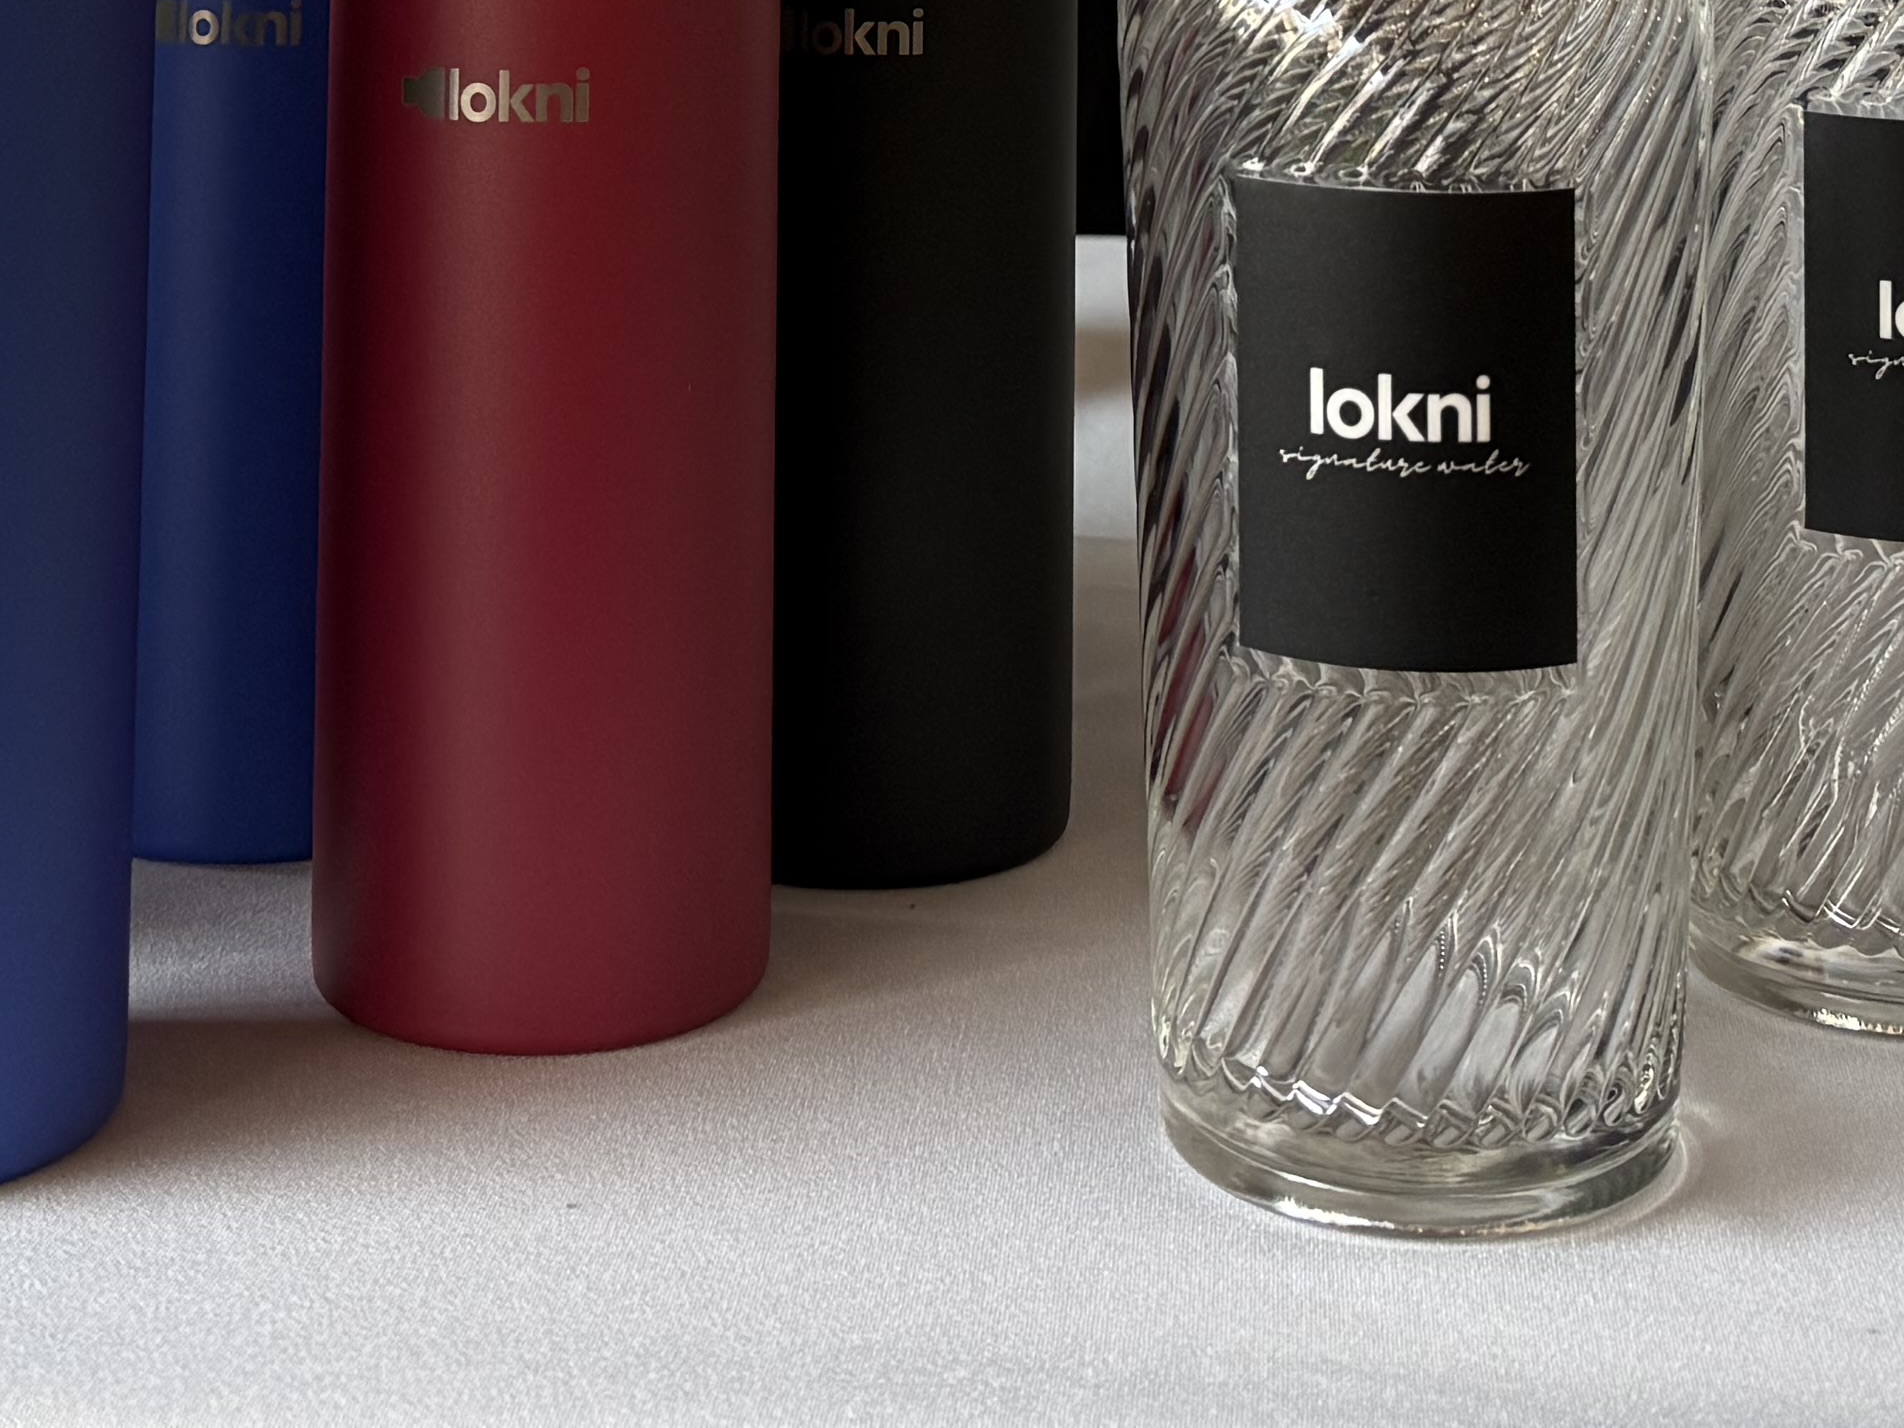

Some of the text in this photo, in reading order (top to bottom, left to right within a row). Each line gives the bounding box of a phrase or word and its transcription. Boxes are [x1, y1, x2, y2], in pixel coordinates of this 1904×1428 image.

[448, 66, 591, 123] lokni
[1309, 367, 1491, 443] lokni
[1279, 446, 1531, 480] signature water
